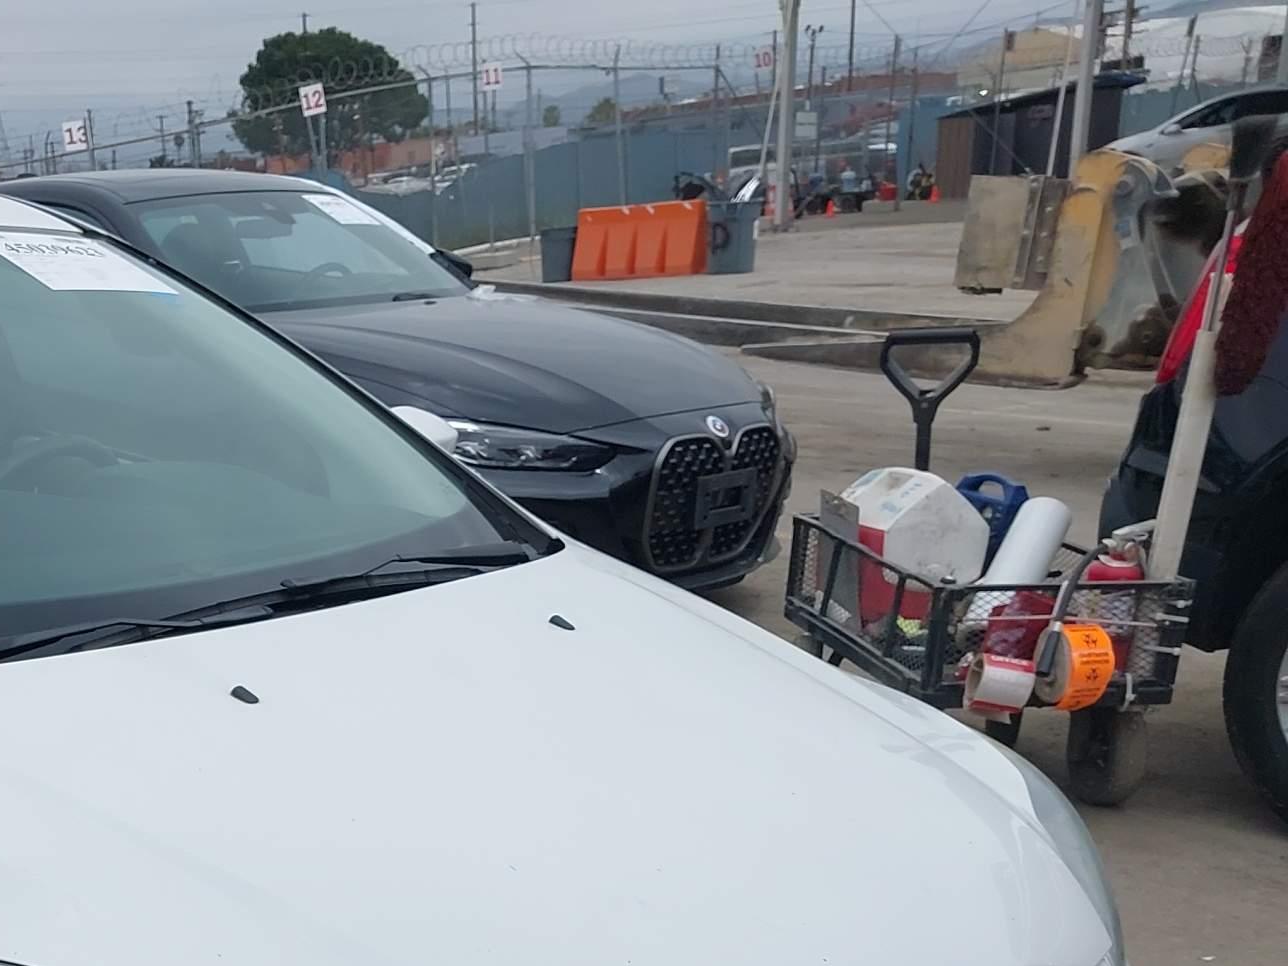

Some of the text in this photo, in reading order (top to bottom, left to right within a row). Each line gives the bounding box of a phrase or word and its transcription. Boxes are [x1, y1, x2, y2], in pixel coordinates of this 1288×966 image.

[754, 51, 772, 68] 10
[484, 67, 500, 85] 11
[302, 90, 324, 110] 12
[63, 126, 88, 145] 13
